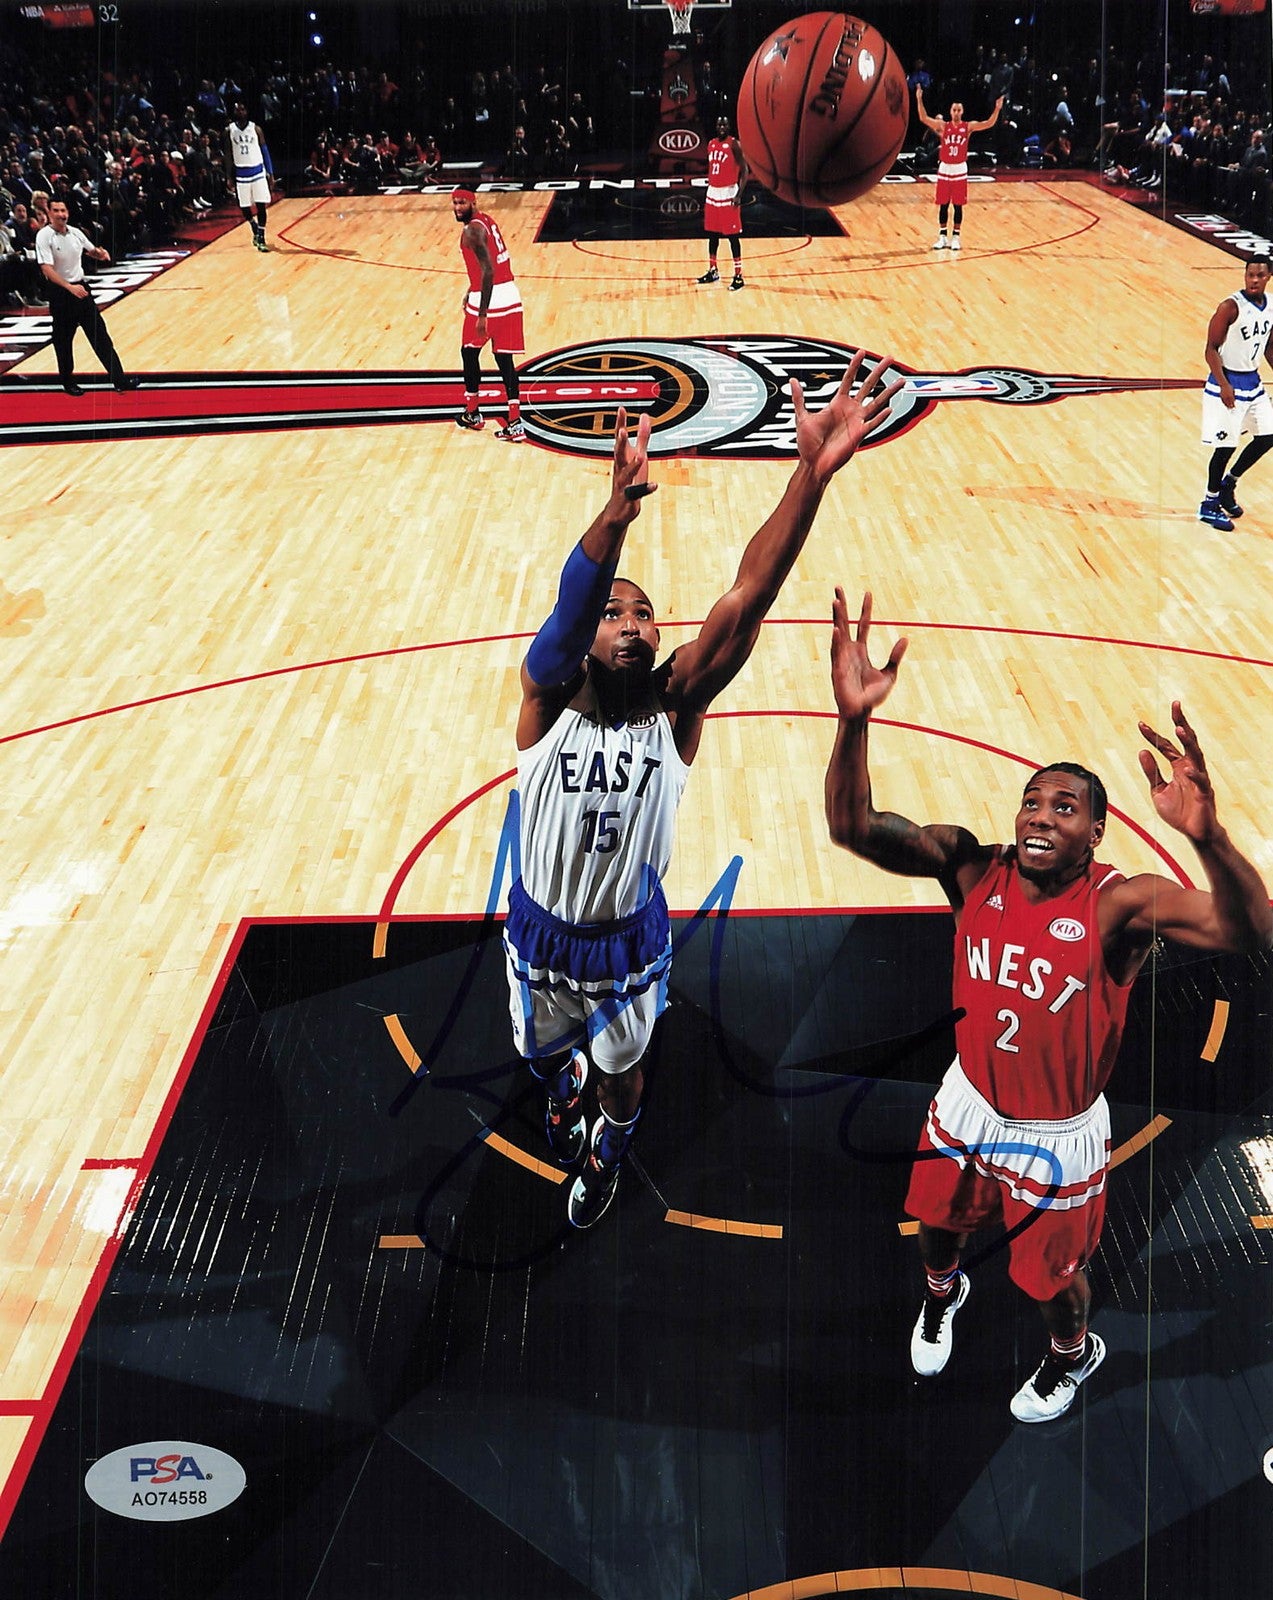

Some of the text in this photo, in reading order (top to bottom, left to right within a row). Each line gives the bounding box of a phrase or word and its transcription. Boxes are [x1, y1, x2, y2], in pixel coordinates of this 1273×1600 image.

[98, 4, 119, 22] 32
[665, 135, 693, 149] KIA
[948, 145, 959, 157] 30
[1240, 320, 1270, 341] EAS
[1251, 343, 1260, 361] 7
[559, 751, 662, 799] EAST
[580, 809, 621, 855] 15
[1055, 923, 1077, 937] KIA
[965, 935, 1086, 1014] WEST
[995, 1008, 1021, 1054] 2
